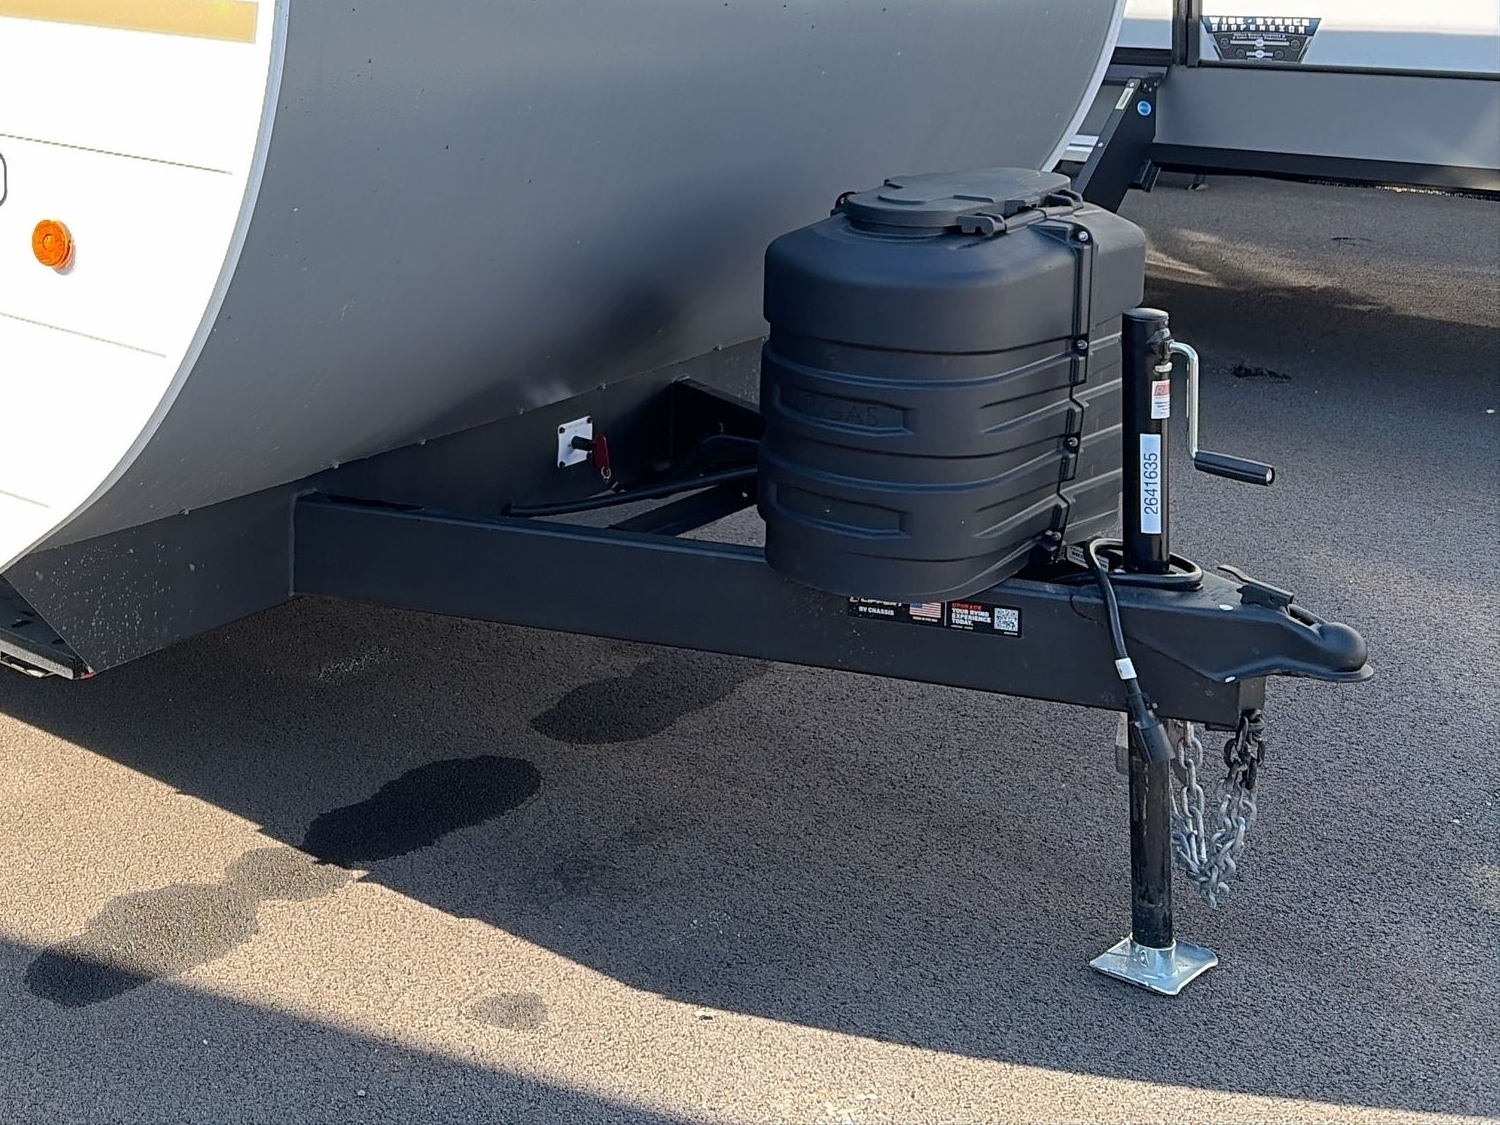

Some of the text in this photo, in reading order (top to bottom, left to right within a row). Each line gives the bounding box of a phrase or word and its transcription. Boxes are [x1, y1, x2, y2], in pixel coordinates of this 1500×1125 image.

[1143, 453, 1159, 515] 2641635
[868, 607, 895, 616] CHASSIS
[952, 613, 991, 623] EXPERIENCE
